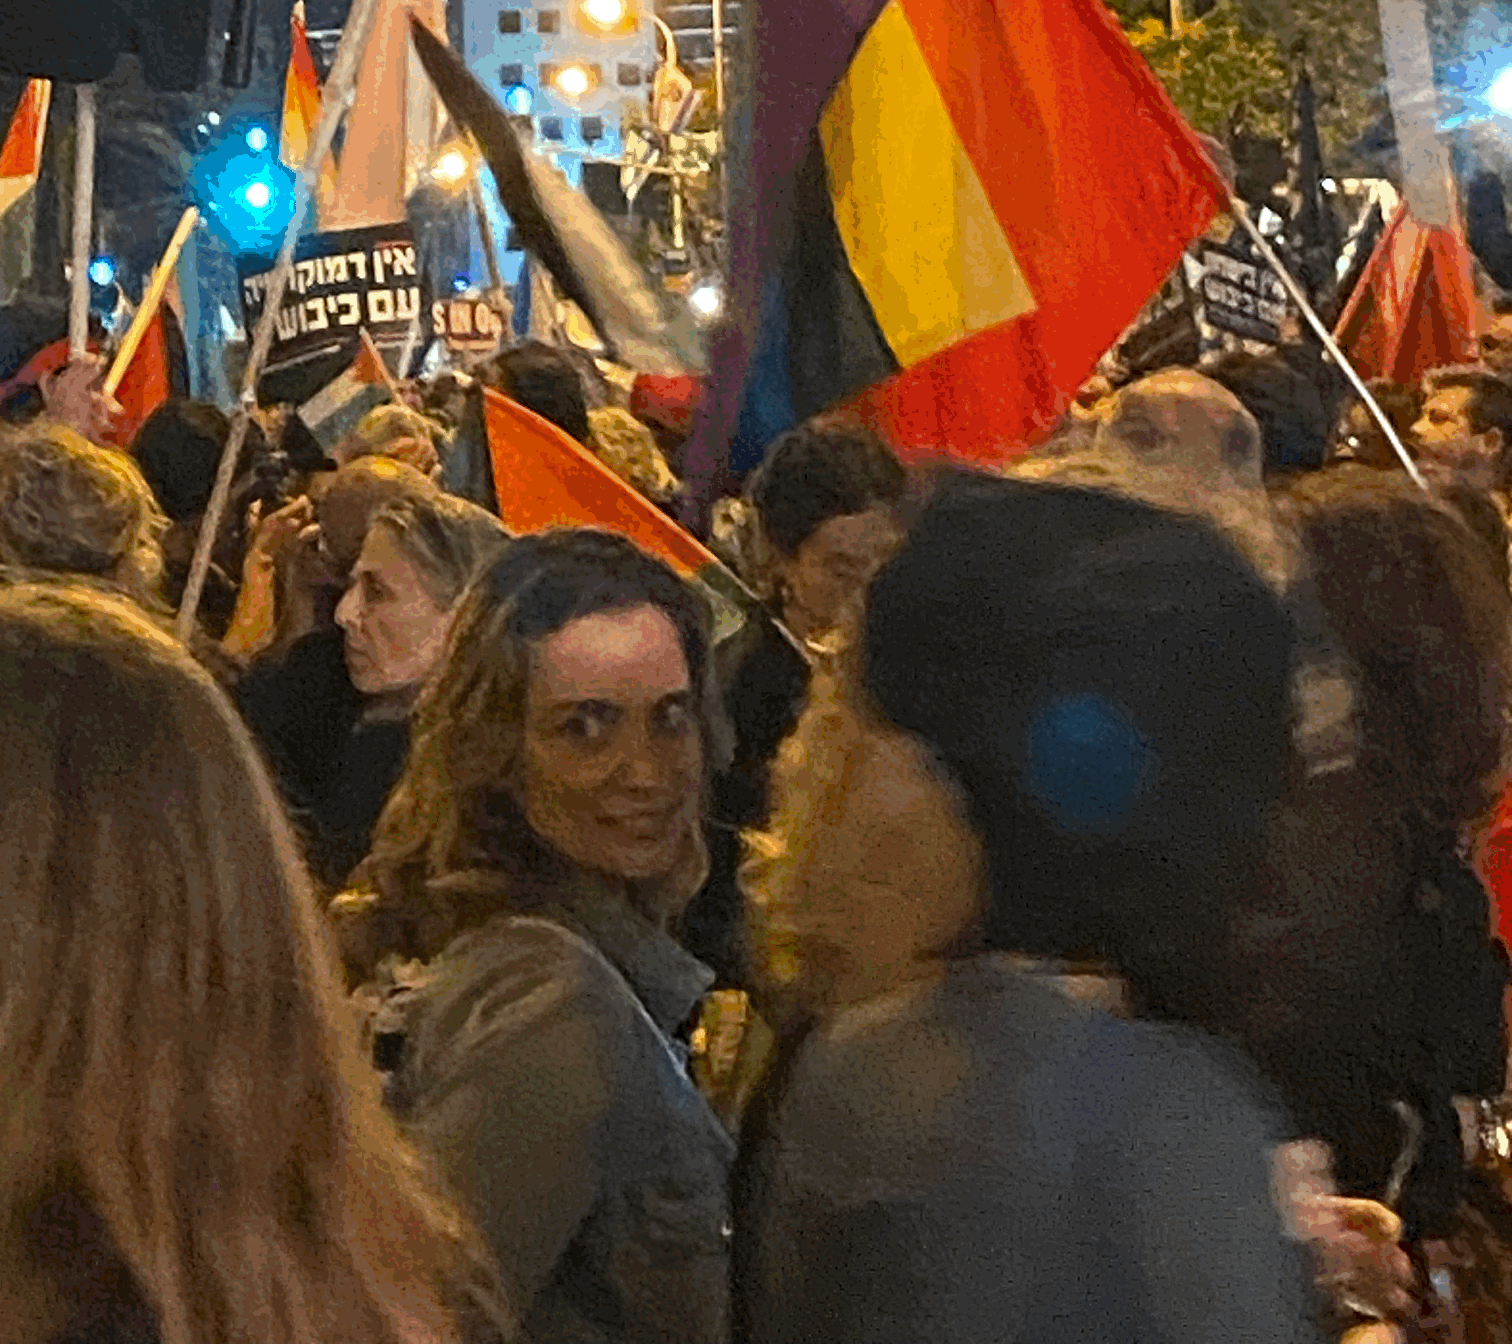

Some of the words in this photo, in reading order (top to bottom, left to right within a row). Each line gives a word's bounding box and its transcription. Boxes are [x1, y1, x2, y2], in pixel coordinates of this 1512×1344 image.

[372, 246, 417, 283] אין
[274, 293, 359, 340] כיבוש
[367, 287, 420, 322] עם
